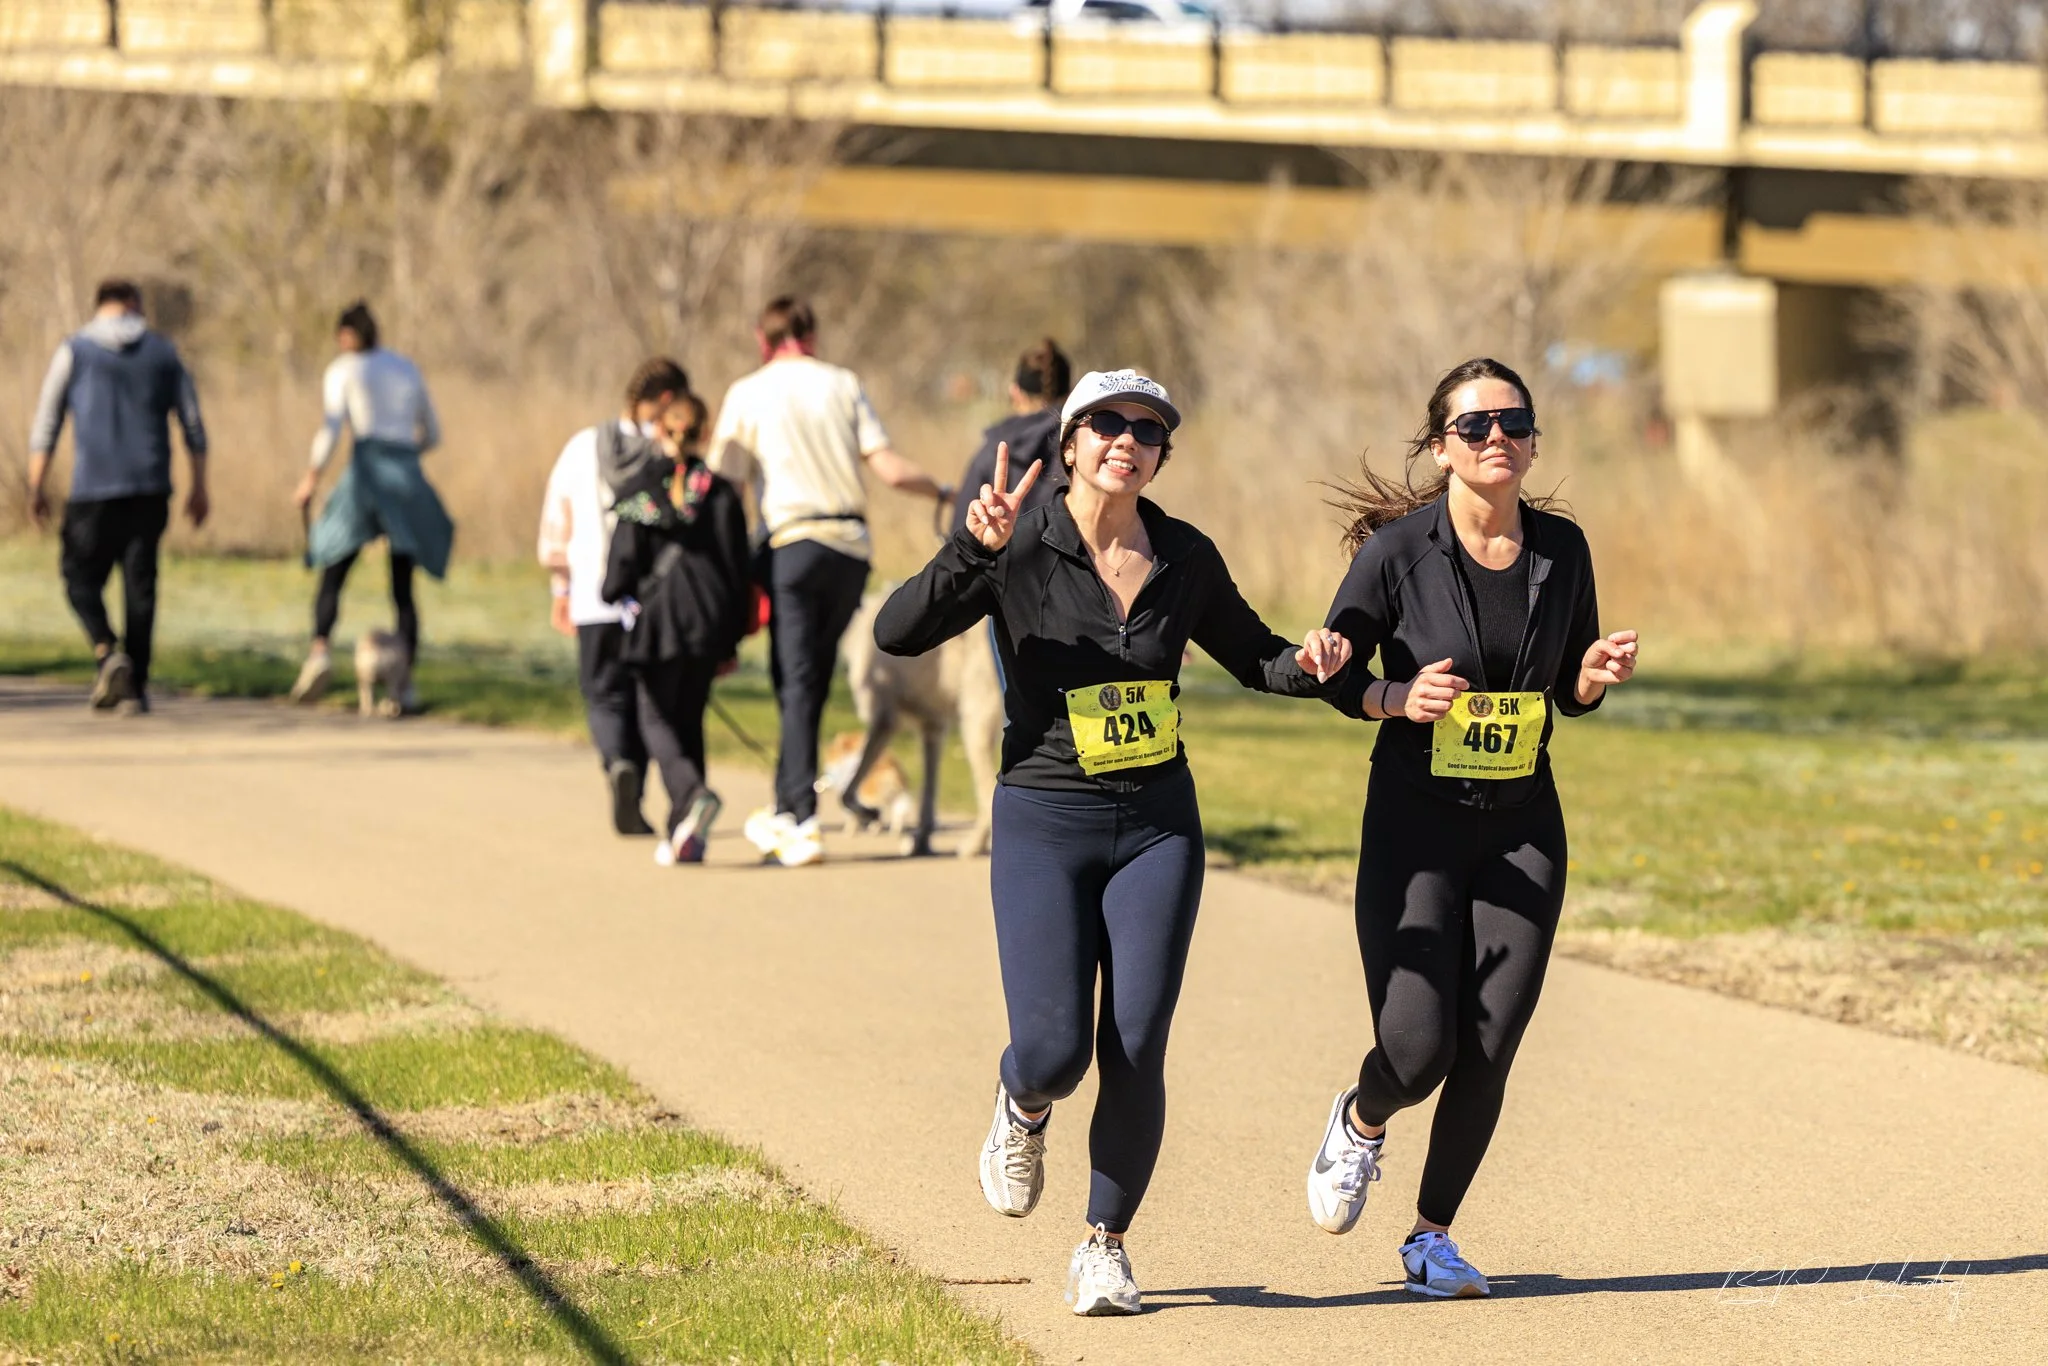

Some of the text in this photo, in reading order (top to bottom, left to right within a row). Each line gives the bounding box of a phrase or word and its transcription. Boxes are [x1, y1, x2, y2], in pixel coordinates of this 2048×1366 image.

[1126, 685, 1146, 704] 5K
[1499, 698, 1520, 716] 5K
[1104, 711, 1156, 746] 424
[1463, 721, 1518, 754] 467
[1094, 759, 1106, 767] Good
